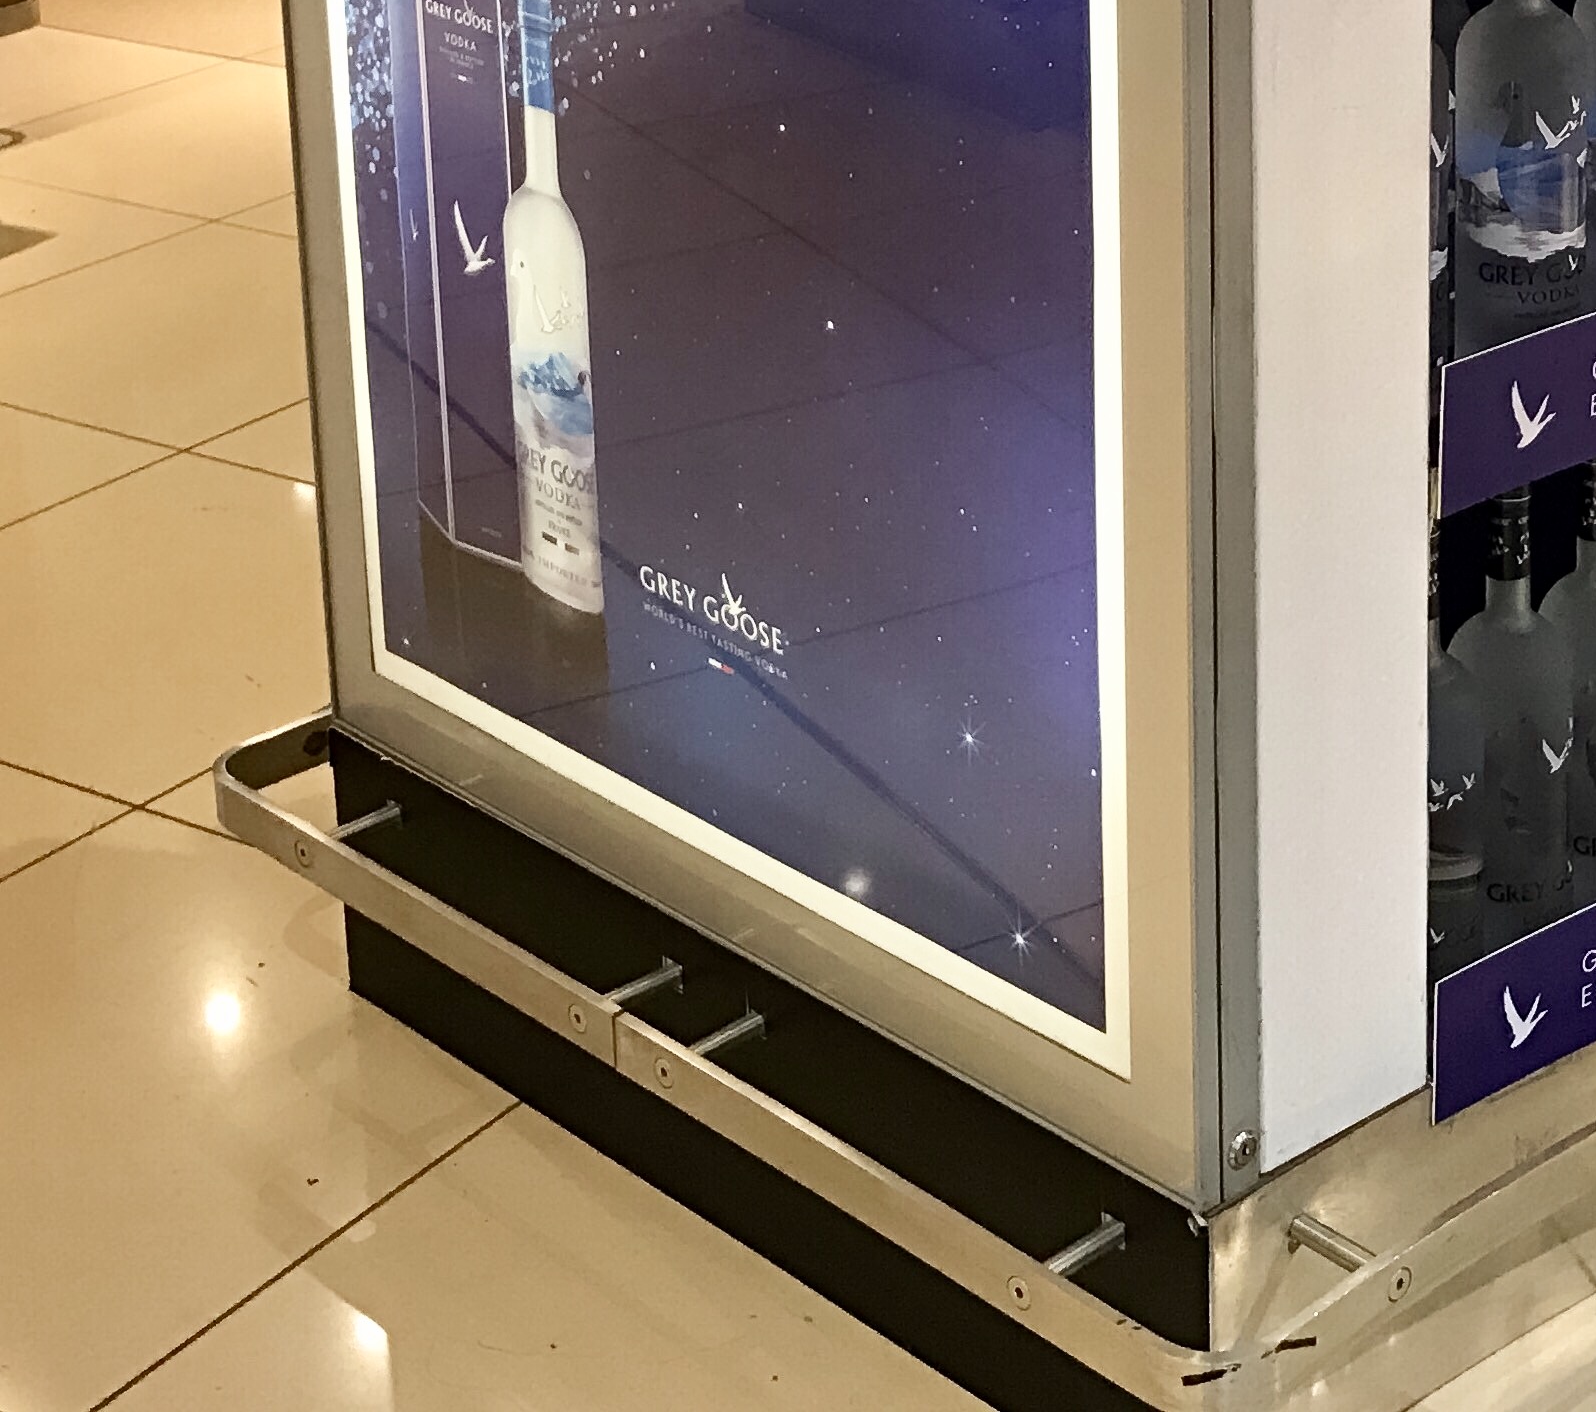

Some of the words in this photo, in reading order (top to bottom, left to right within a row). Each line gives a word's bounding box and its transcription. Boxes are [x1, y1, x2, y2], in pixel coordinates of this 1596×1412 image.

[454, 8, 494, 34] GOOSE
[444, 32, 477, 52] VODKA
[1478, 262, 1535, 286] GREY
[535, 478, 582, 511] VODKA
[639, 565, 696, 612] GREY
[703, 595, 784, 656] GOOSE
